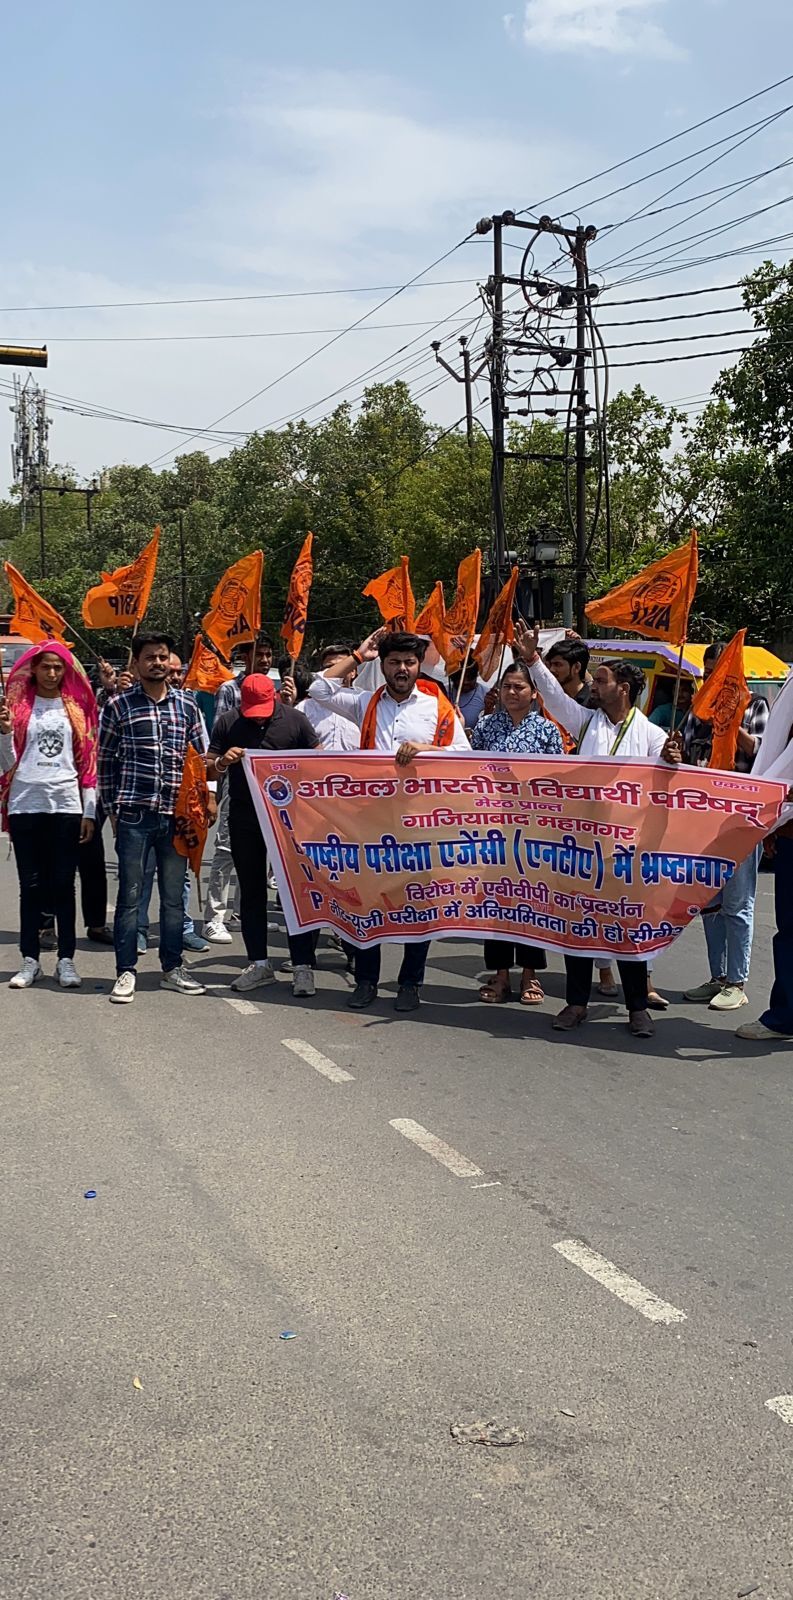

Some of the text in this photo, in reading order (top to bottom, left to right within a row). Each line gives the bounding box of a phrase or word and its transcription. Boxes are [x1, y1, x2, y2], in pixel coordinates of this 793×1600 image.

[298, 774, 398, 797] अखिल
[404, 775, 520, 796] भारतीय
[529, 779, 640, 806] विद्यार्थी
[649, 789, 767, 829] परिषद्
[474, 798, 562, 812] मेरठ प्रान्त
[402, 808, 637, 840] गाजियाबाद महानगर
[364, 834, 432, 873] परीक्षा
[438, 829, 507, 868] एजेंसी
[514, 829, 603, 889] (एनटीए)
[613, 844, 635, 884] में
[641, 852, 736, 889] भ्रष्टाचार
[406, 879, 456, 901] विरोध
[461, 877, 479, 895] में
[482, 876, 549, 903] एबीवीपी
[554, 891, 576, 910] का
[580, 893, 644, 918] प्रदर्शन
[388, 906, 438, 924] परीक्षा
[444, 900, 462, 919] में
[465, 901, 566, 933] अनियमितता
[571, 918, 598, 938] की
[603, 923, 624, 944] हो
